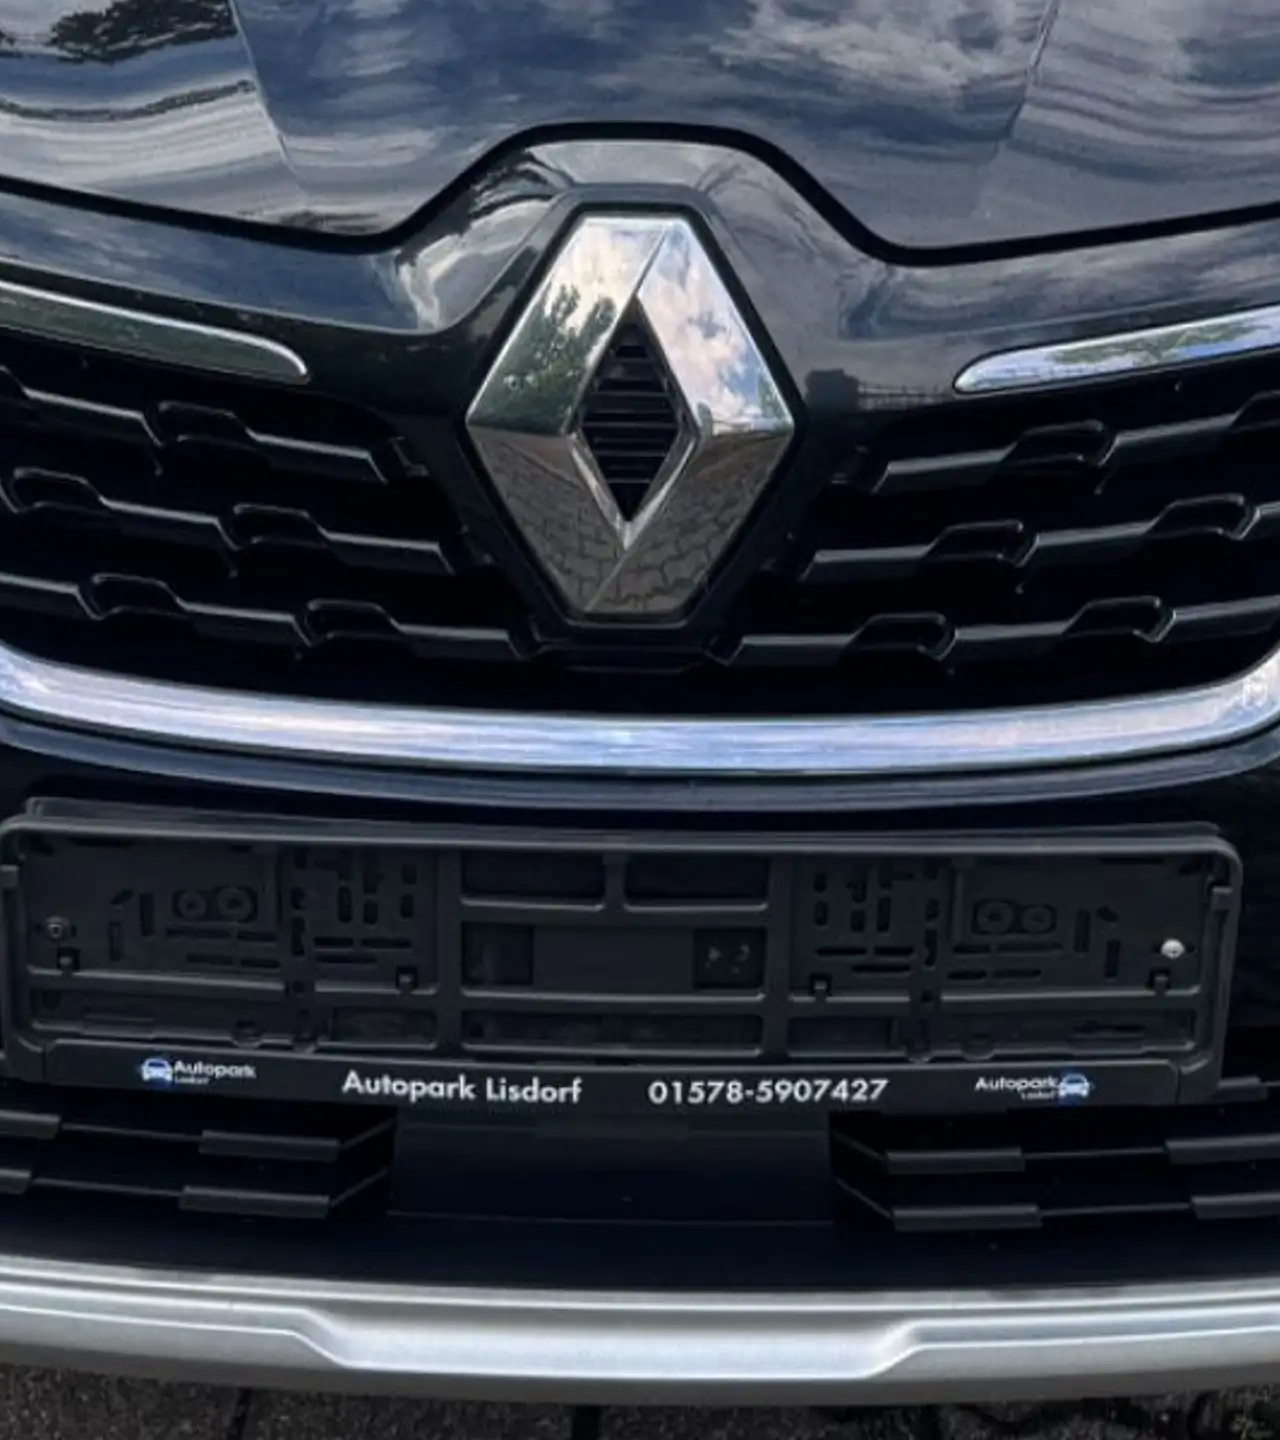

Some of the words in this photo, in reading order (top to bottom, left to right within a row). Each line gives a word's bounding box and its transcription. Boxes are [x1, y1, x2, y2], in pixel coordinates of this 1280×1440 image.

[173, 1060, 257, 1079] Autopark
[342, 1069, 476, 1103] Autopark
[486, 1077, 582, 1103] Lisdorf
[648, 1078, 889, 1104] 01578-5907427
[974, 1076, 1059, 1092] Autopark
